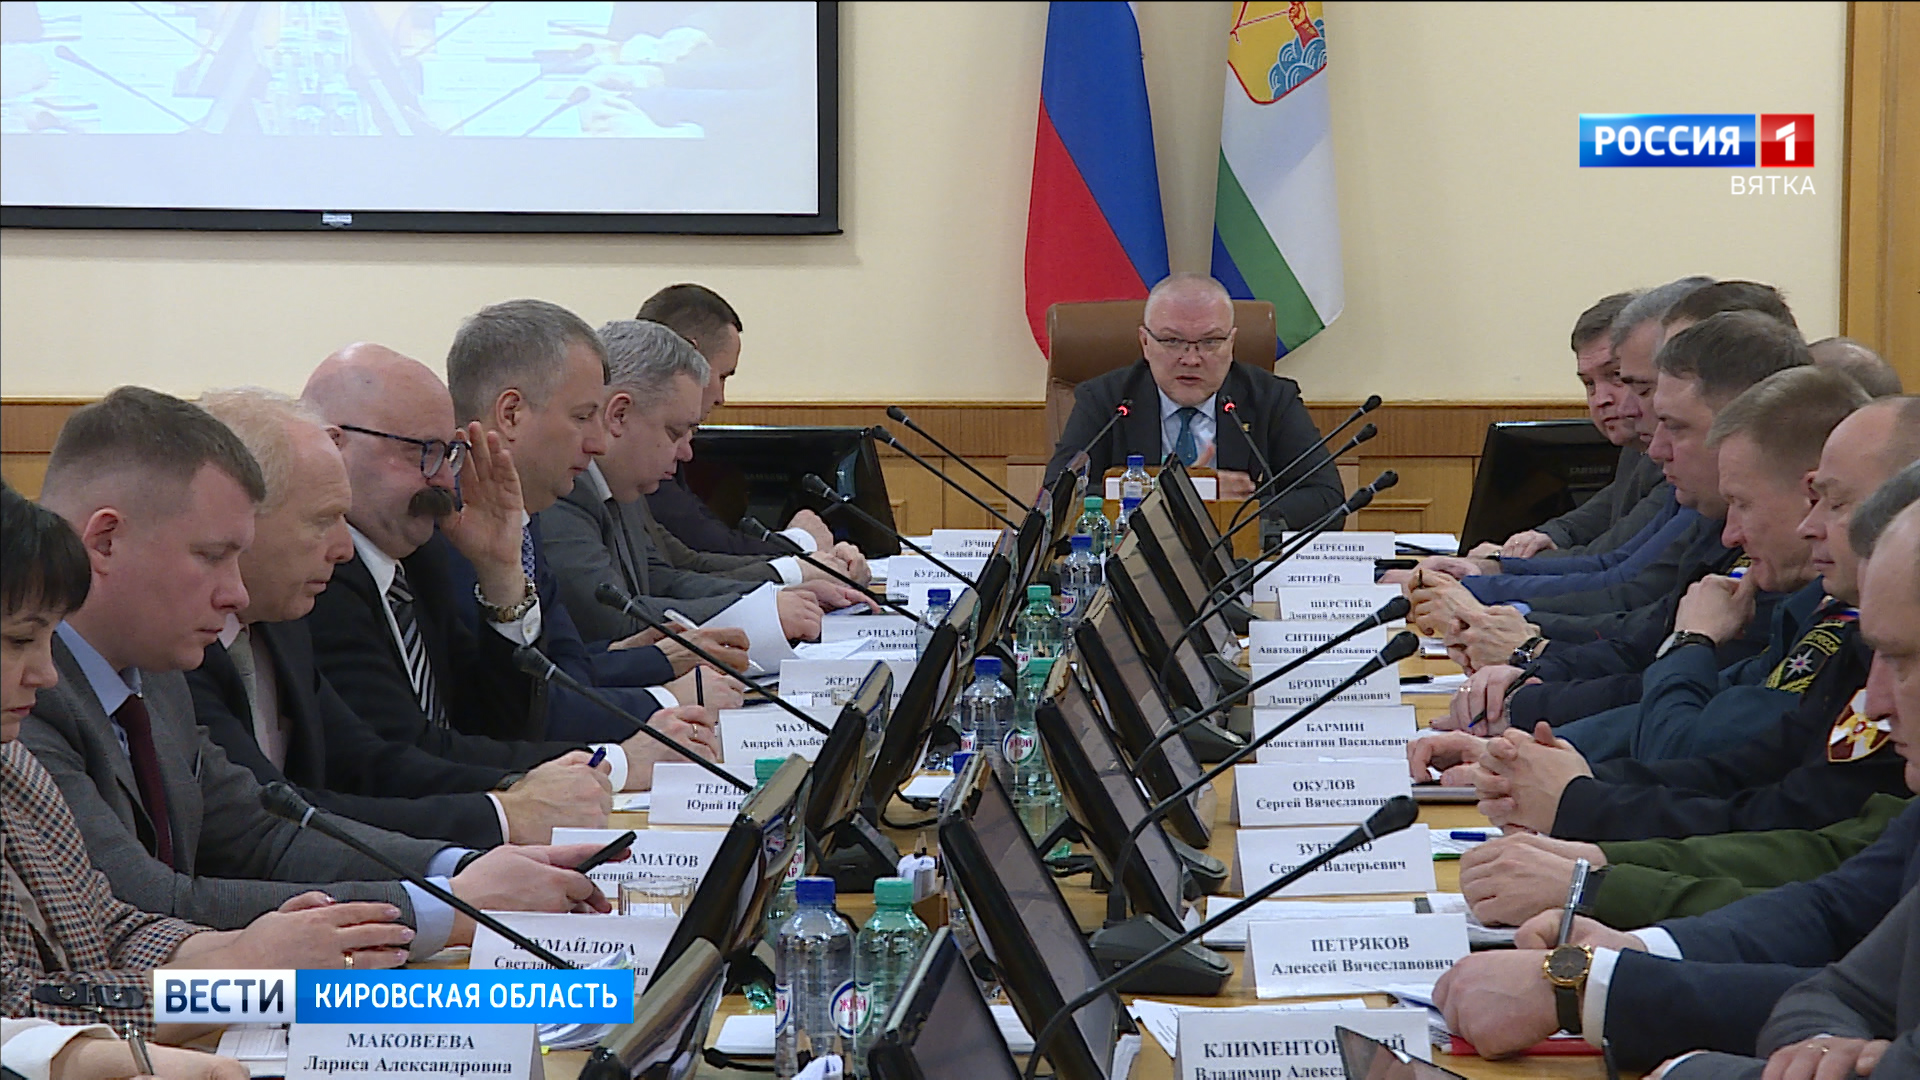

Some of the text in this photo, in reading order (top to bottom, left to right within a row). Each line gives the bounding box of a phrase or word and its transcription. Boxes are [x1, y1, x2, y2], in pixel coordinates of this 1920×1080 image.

[857, 629, 917, 638] САНДАЛО
[740, 739, 783, 749] Андрей
[1293, 779, 1356, 791] ОКУЛОВ
[687, 799, 723, 811] Юрий
[1256, 797, 1301, 811] Сергей
[624, 853, 699, 868] АМАТОВ
[1311, 936, 1410, 953] ПЕТРЯКОВ
[1271, 958, 1454, 976] Алексей Вячеславович
[346, 1033, 475, 1050] МАКОВЕЕВА
[303, 1055, 512, 1076] Лариса Александровна
